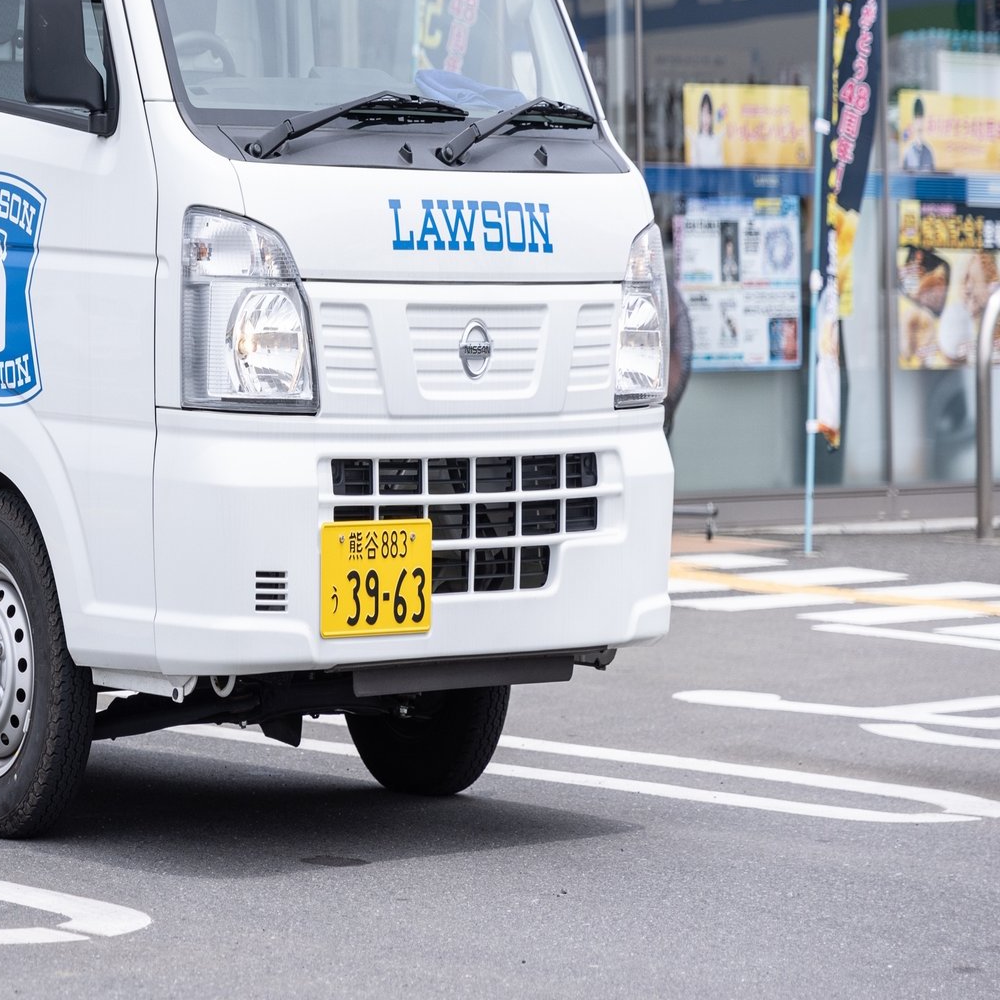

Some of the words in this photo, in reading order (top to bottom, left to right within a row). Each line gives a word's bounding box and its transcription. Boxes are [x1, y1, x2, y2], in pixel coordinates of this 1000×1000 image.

[388, 199, 553, 253] LAWSON
[464, 344, 490, 354] NISSAN
[346, 567, 426, 626] 39-63
